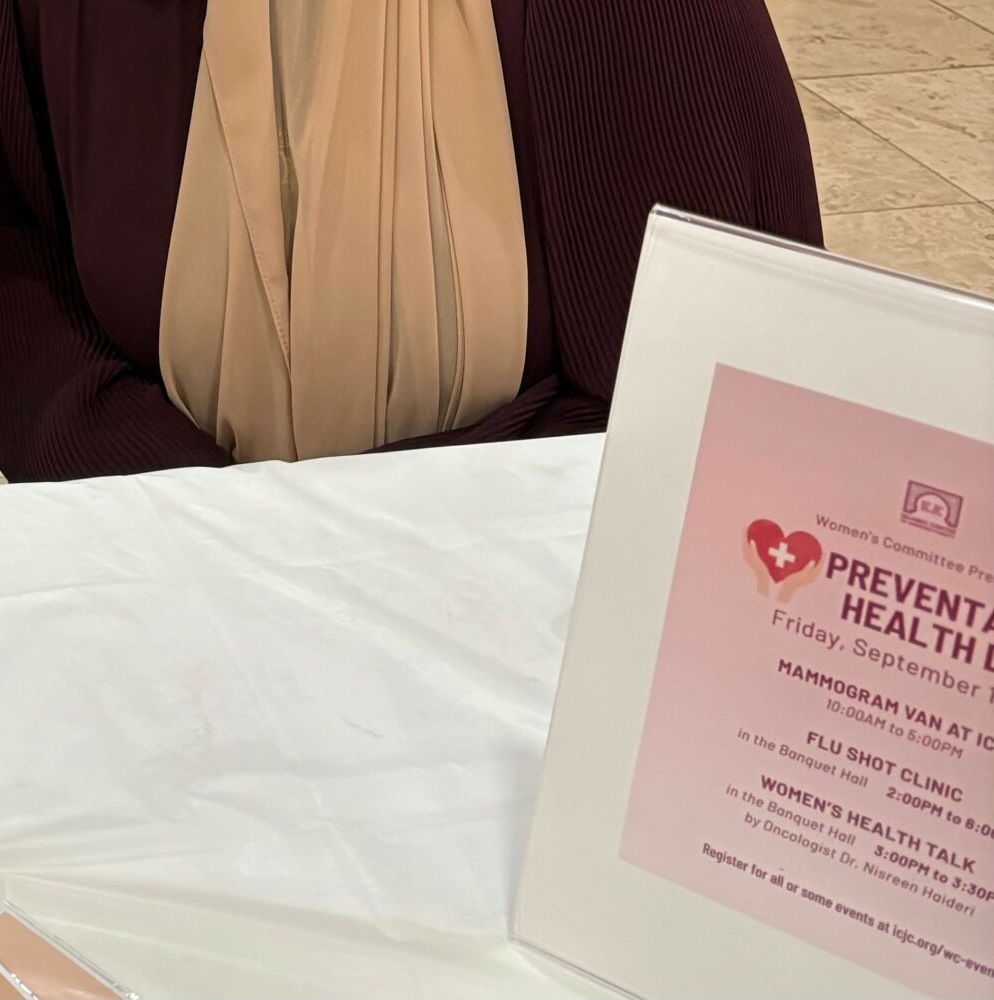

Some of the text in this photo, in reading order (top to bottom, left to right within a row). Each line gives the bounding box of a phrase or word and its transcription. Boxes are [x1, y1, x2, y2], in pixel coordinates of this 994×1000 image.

[816, 514, 879, 545] Women's
[883, 537, 964, 573] Committee
[772, 609, 845, 651] Friday,
[853, 638, 981, 697] September
[840, 593, 976, 665] HEALTH
[777, 658, 899, 715] MAMMOGRAM
[905, 704, 942, 731] VAN
[946, 722, 974, 742] AT
[826, 698, 964, 759] 10:00AM to 5:00PM
[737, 727, 750, 741] in
[753, 734, 776, 751] the
[779, 744, 837, 776] Banquet
[840, 767, 868, 788] Hall
[886, 787, 943, 818] 2:00PM
[946, 811, 962, 826] to
[806, 731, 964, 802] FLU SHOT CLINIC
[726, 784, 739, 798] in
[742, 791, 764, 808] the
[767, 801, 825, 833] Banquet
[828, 826, 856, 846] Hall
[874, 845, 931, 876] 3:00PM
[933, 869, 949, 884] to
[744, 812, 976, 917] by Oncologist Dr. Nisreen Haideri
[761, 774, 977, 874] WOMEN'S HEALTH TALK
[702, 842, 748, 872] Register
[751, 864, 768, 880] for
[770, 874, 784, 888] all
[786, 881, 799, 893] or
[801, 888, 833, 909] some
[835, 903, 875, 927] events
[877, 920, 891, 933] at
